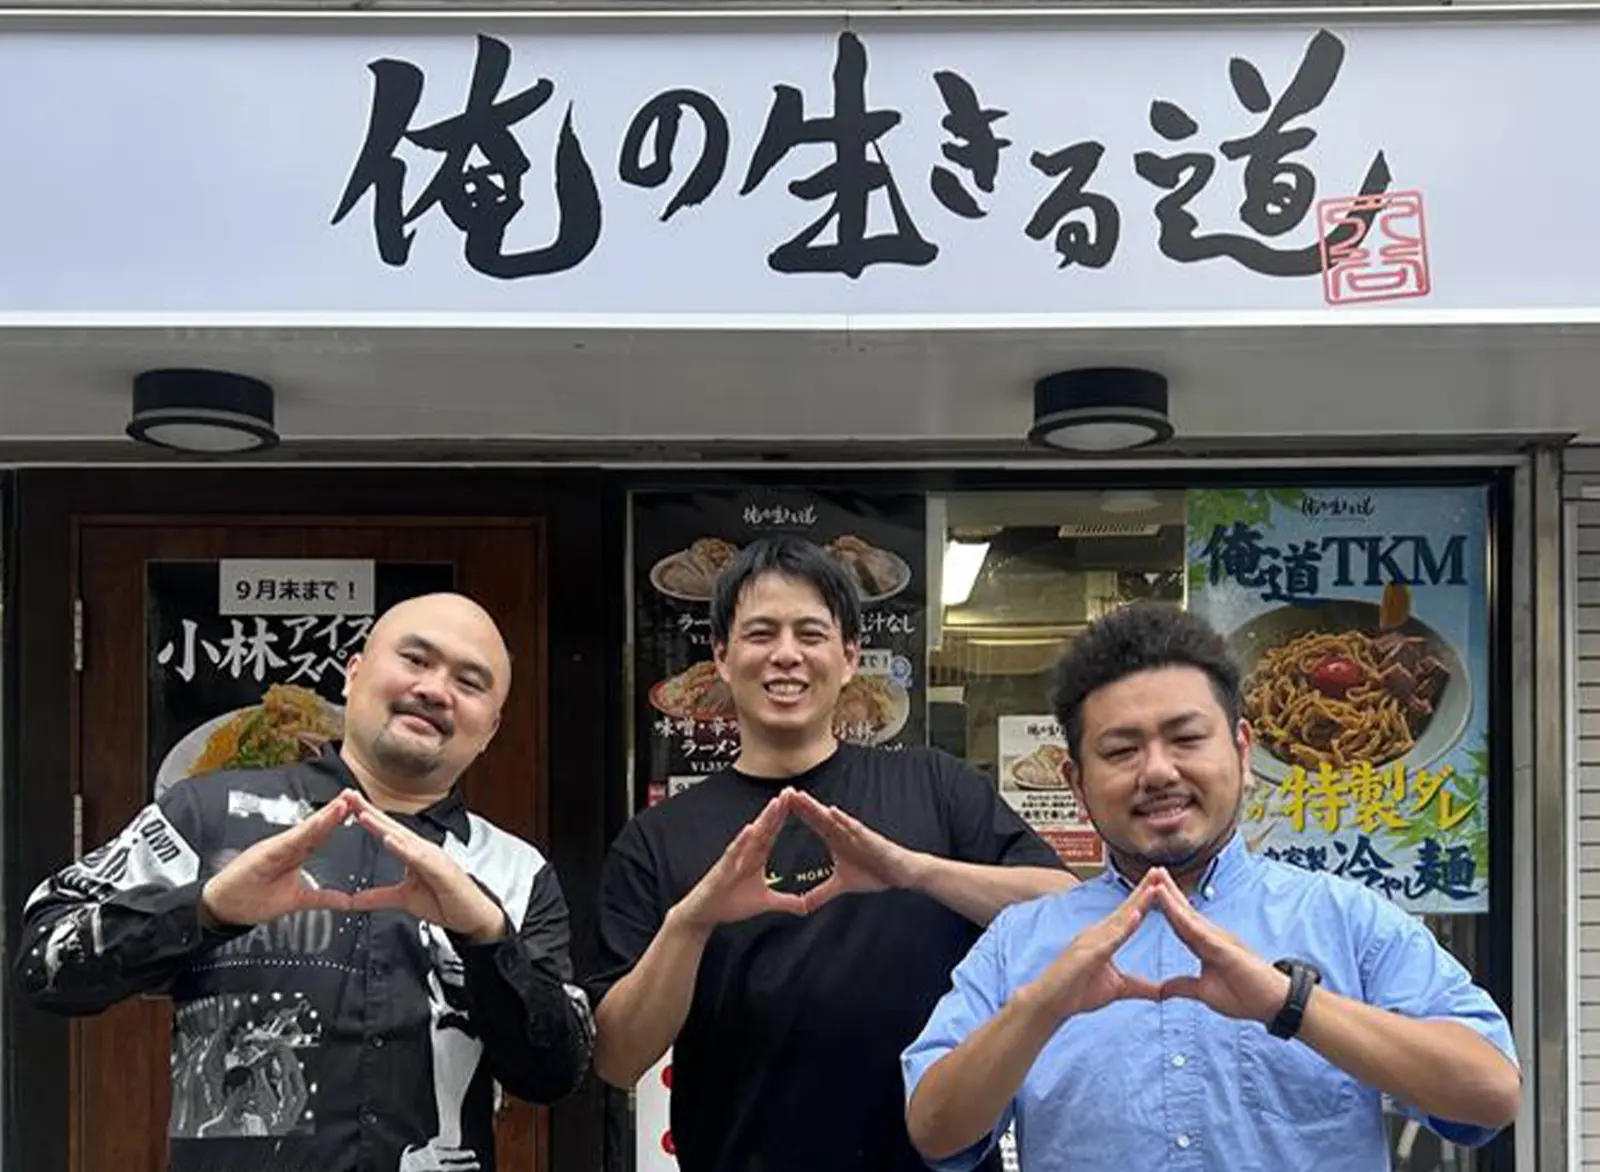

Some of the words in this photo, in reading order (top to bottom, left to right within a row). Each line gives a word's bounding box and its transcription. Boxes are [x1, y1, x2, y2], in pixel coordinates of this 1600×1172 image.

[332, 30, 1394, 279] 俺の生きる道
[157, 617, 288, 683] 小林
